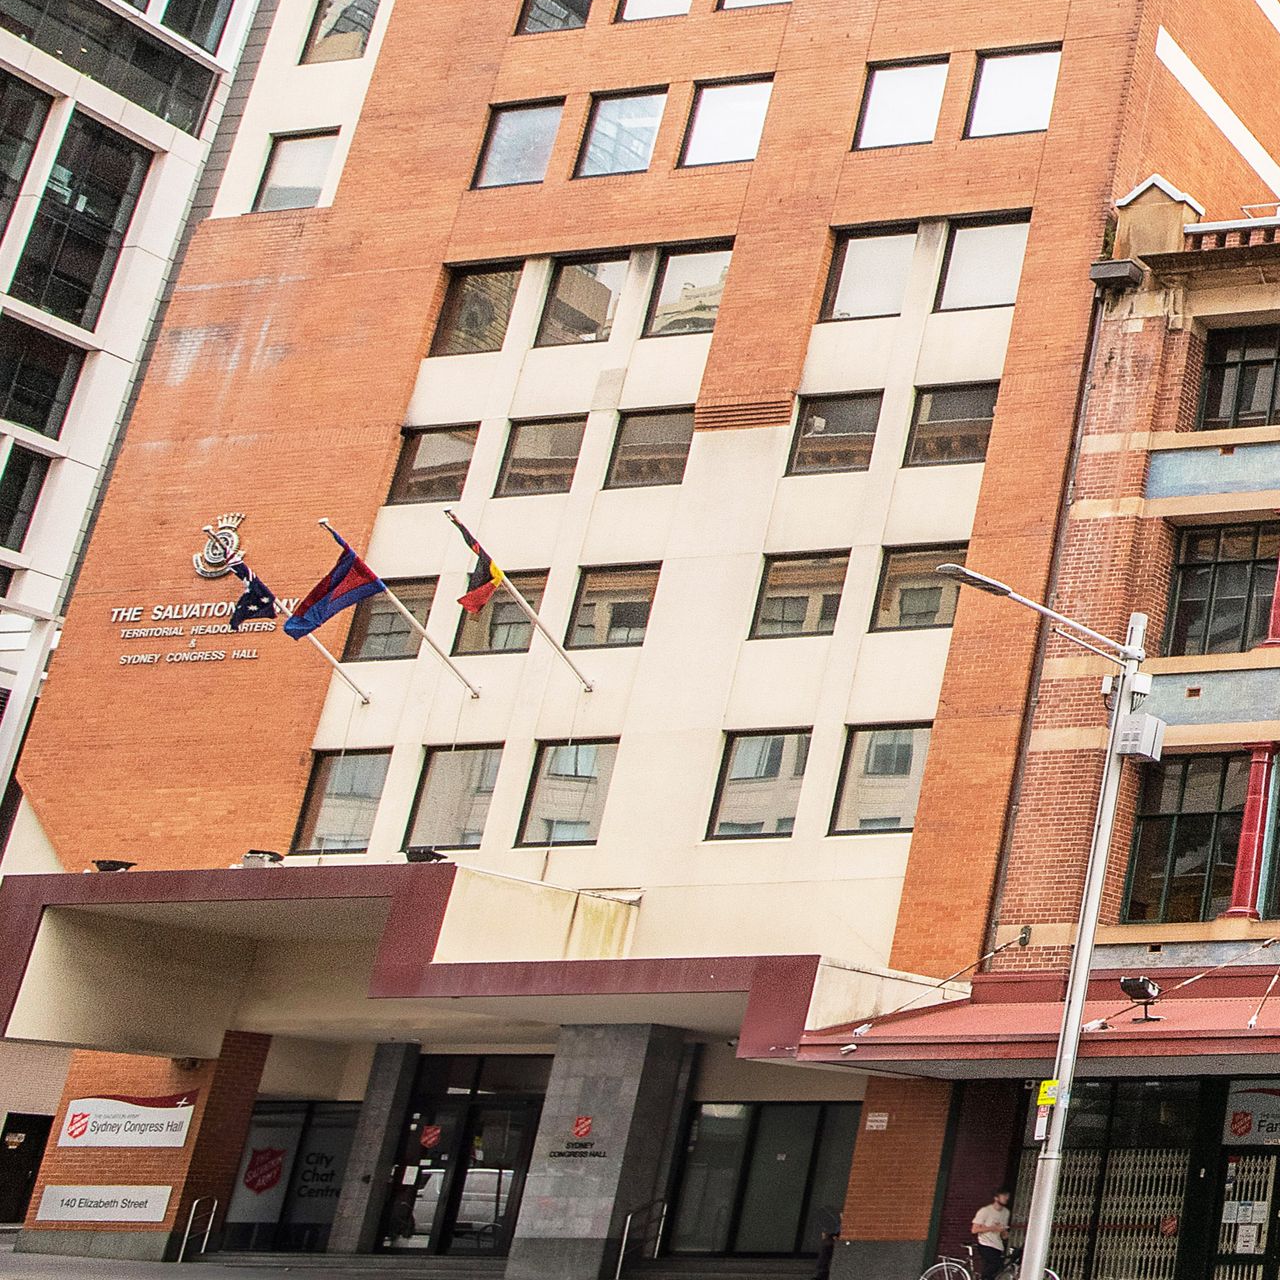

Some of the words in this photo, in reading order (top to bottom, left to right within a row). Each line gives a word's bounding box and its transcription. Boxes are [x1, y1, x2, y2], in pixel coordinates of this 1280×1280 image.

[111, 607, 144, 623] THE
[120, 627, 184, 639] TERRITORIAL
[189, 639, 196, 648] &
[119, 653, 161, 665] SYDNEY
[166, 651, 226, 662] CONGRESS
[232, 649, 259, 659] HALL
[90, 1121, 122, 1134] Sydney
[124, 1121, 164, 1134] Congress
[166, 1121, 184, 1132] Hall
[305, 1153, 334, 1168] City
[302, 1170, 335, 1182] Chat
[59, 1199, 76, 1208] 140
[78, 1198, 119, 1208] Elizabeth
[120, 1198, 149, 1209] Street
